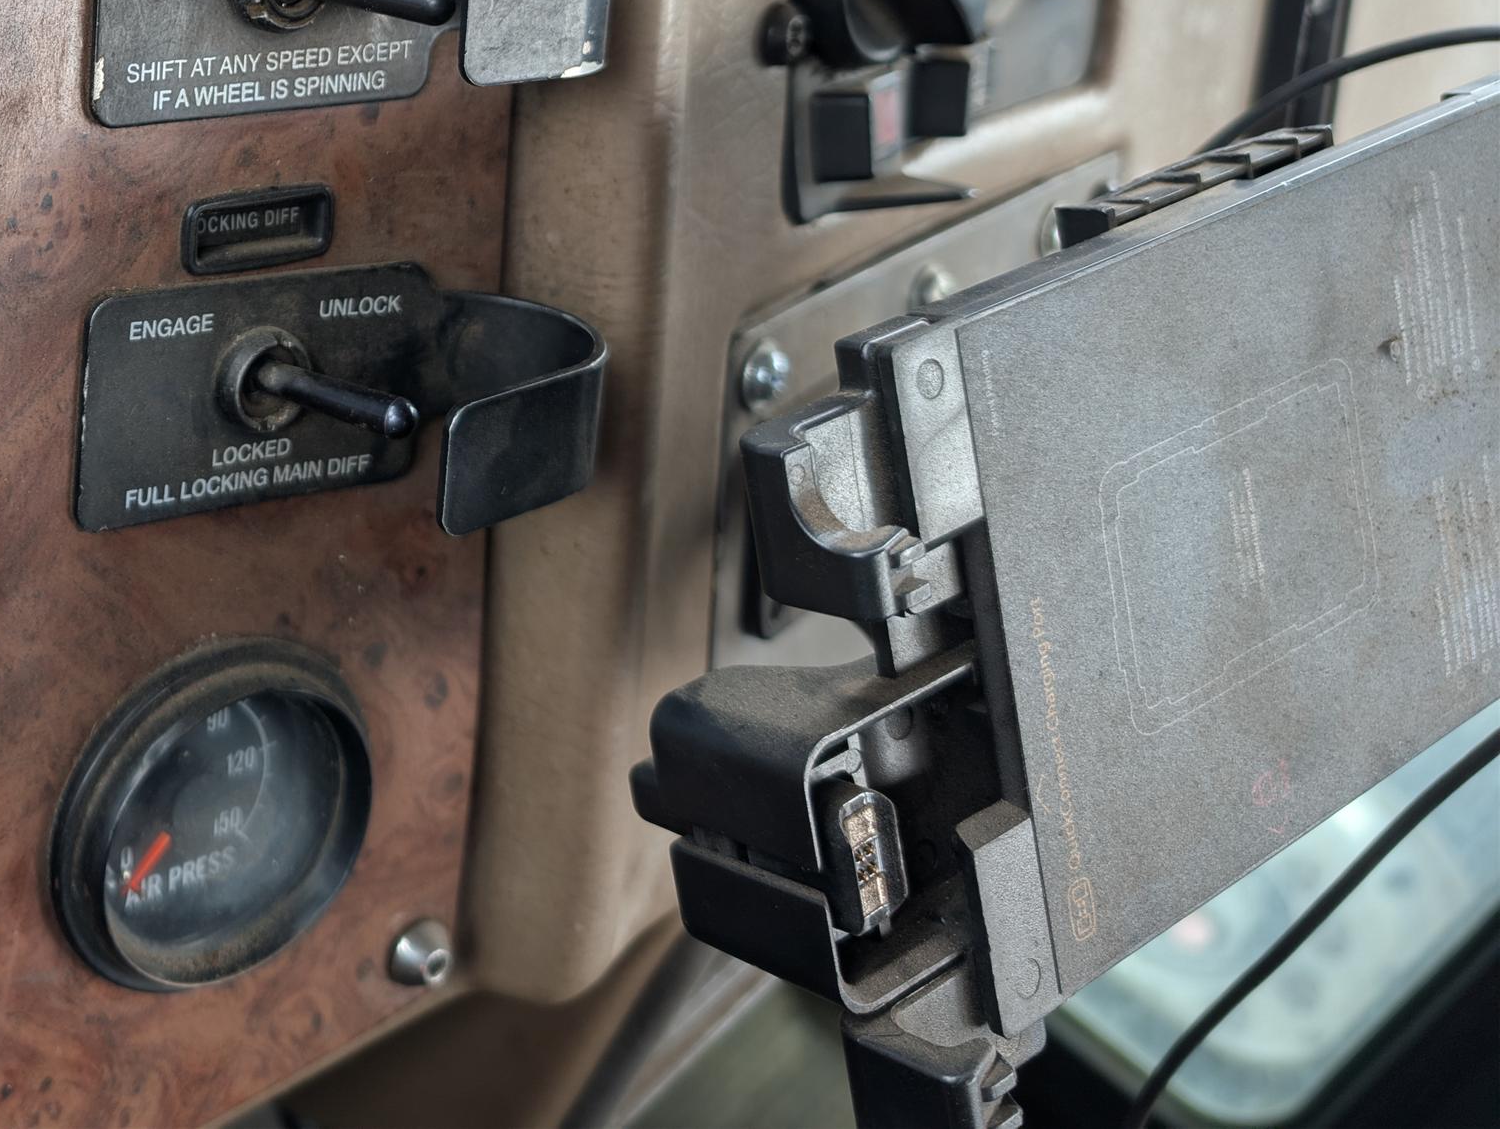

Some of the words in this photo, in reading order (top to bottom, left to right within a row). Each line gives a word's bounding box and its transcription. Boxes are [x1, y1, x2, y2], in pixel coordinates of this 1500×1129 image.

[126, 59, 187, 84] SHIFT
[191, 56, 217, 78] AT
[220, 53, 262, 75] ANY
[266, 47, 331, 71] SPEED
[337, 40, 413, 65] EXCEPT
[152, 89, 172, 111] IF
[174, 87, 190, 109] A
[195, 82, 265, 107] WHEEL
[270, 79, 288, 100] IS
[293, 70, 385, 98] SPINNING
[197, 211, 259, 234] OCKING
[264, 206, 300, 227] DIFF
[318, 294, 401, 319] UNLOCK
[129, 313, 215, 341] ENGAGE
[211, 437, 291, 467] LOCKED
[125, 484, 175, 510] FULL
[180, 468, 268, 502] LOCKING
[272, 458, 322, 485] MAIN
[327, 453, 373, 477] DIFF
[1029, 596, 1045, 639] Port
[1039, 640, 1059, 731] Charging
[226, 746, 256, 777] 120
[213, 806, 243, 837] 150
[168, 846, 237, 894] PRESS
